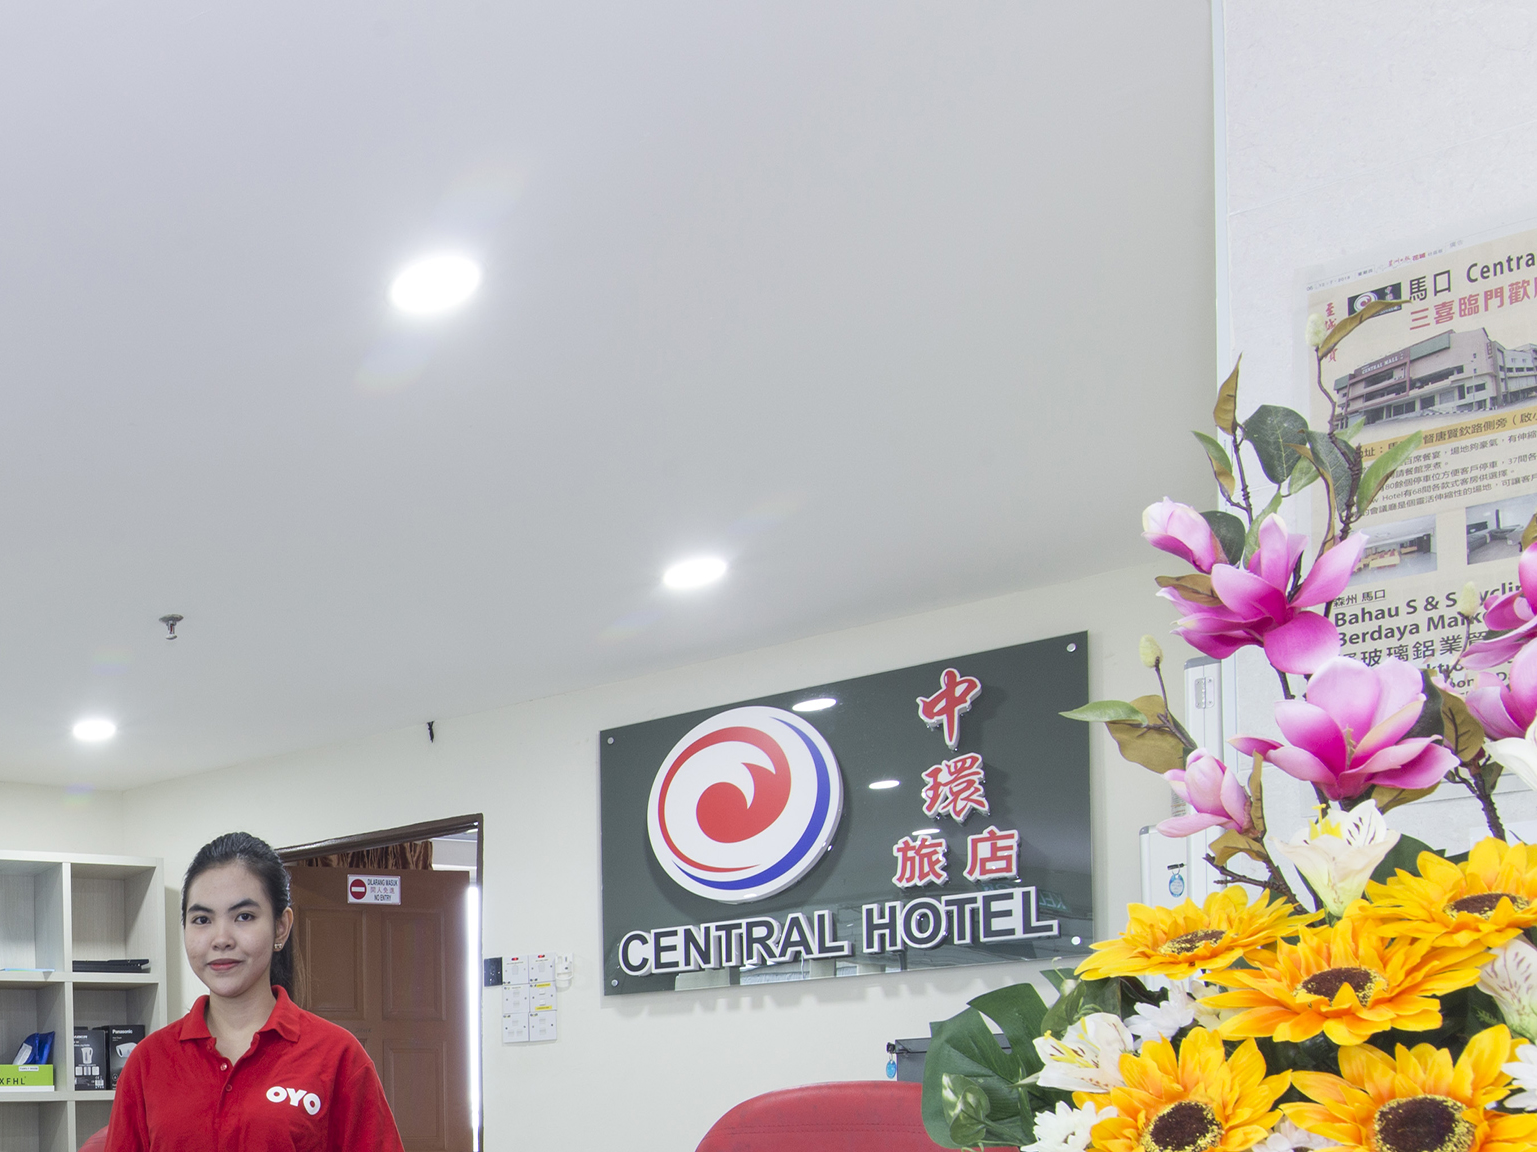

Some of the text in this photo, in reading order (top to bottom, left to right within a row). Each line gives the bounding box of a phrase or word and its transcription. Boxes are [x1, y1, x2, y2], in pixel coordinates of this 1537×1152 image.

[1409, 269, 1451, 301] 馬口
[1334, 605, 1400, 627] Bahau
[1406, 599, 1418, 615] S
[1423, 596, 1440, 612] &
[1445, 592, 1458, 608] S
[916, 668, 991, 826] 中環
[893, 825, 1020, 889] 旅店
[618, 886, 1061, 977] CENTRAL HOTEL
[0, 1077, 25, 1085] XFHL
[266, 1086, 321, 1115] OYO
